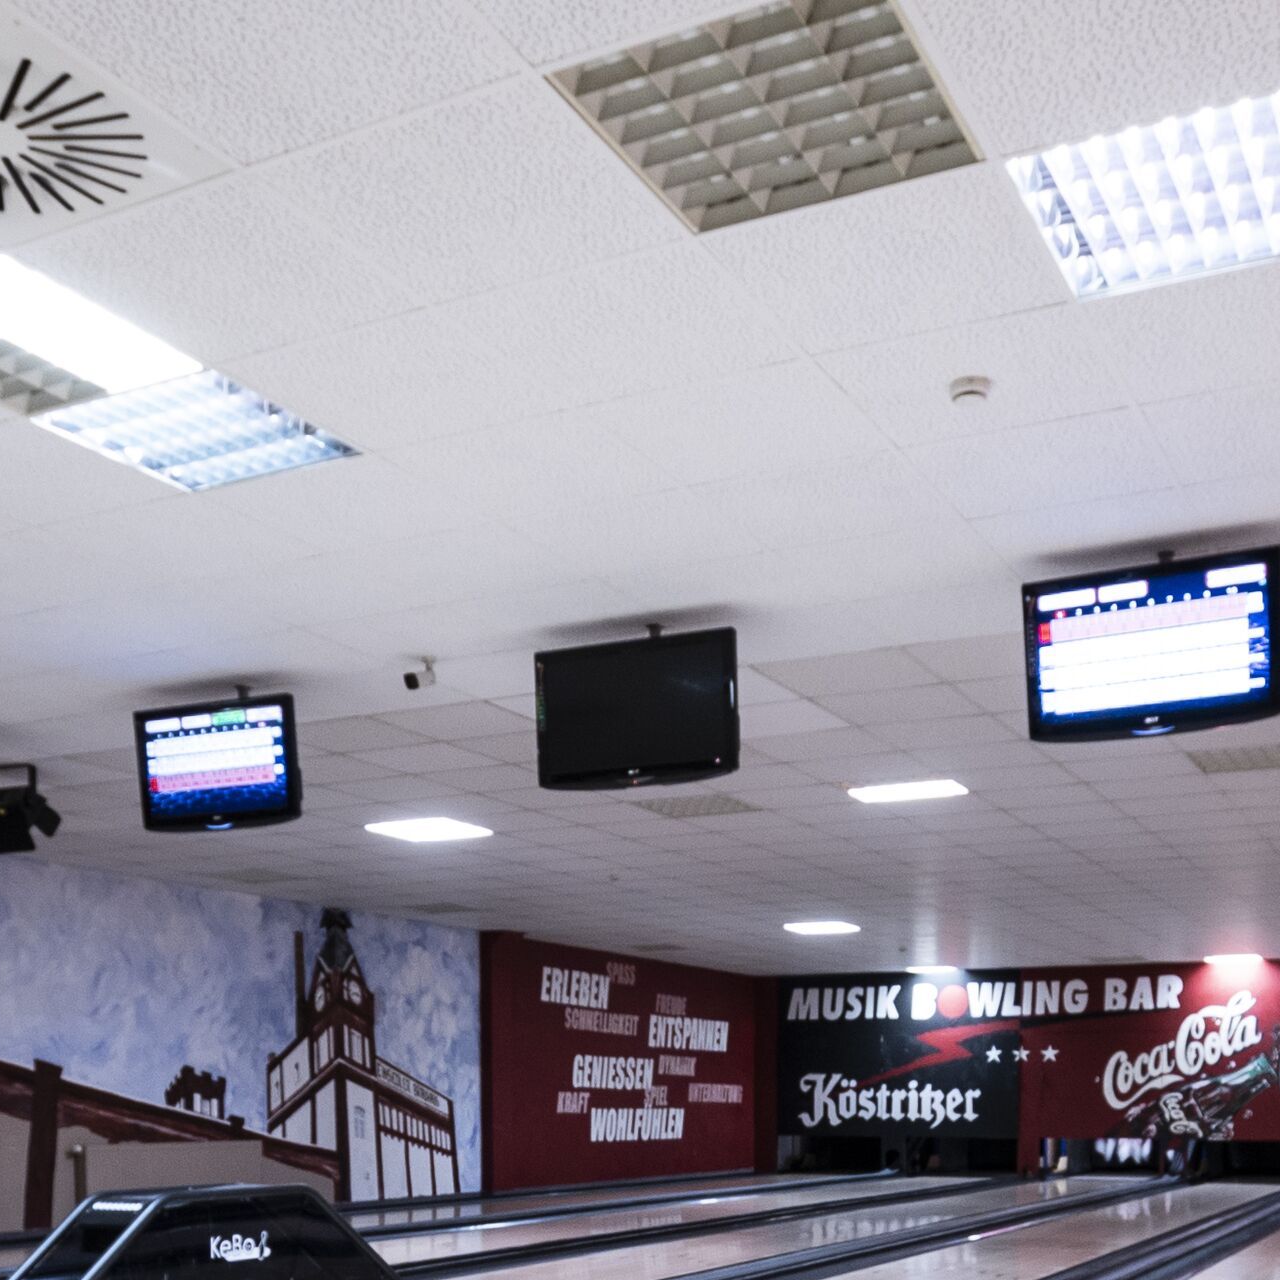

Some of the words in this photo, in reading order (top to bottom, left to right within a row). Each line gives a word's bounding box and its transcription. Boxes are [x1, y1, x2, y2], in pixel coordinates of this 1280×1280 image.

[541, 966, 610, 1009] ERLEBEN
[787, 984, 901, 1020] MUSIK
[1104, 975, 1184, 1012] BAR
[564, 1007, 640, 1036] SCHNELLIGKEIT
[648, 1014, 730, 1052] ENTSPANNEN
[573, 1054, 654, 1090] GENIESSEN
[556, 1091, 591, 1114] KRAFT
[798, 1072, 981, 1128] Köstritzer
[210, 1233, 257, 1260] KeBo
